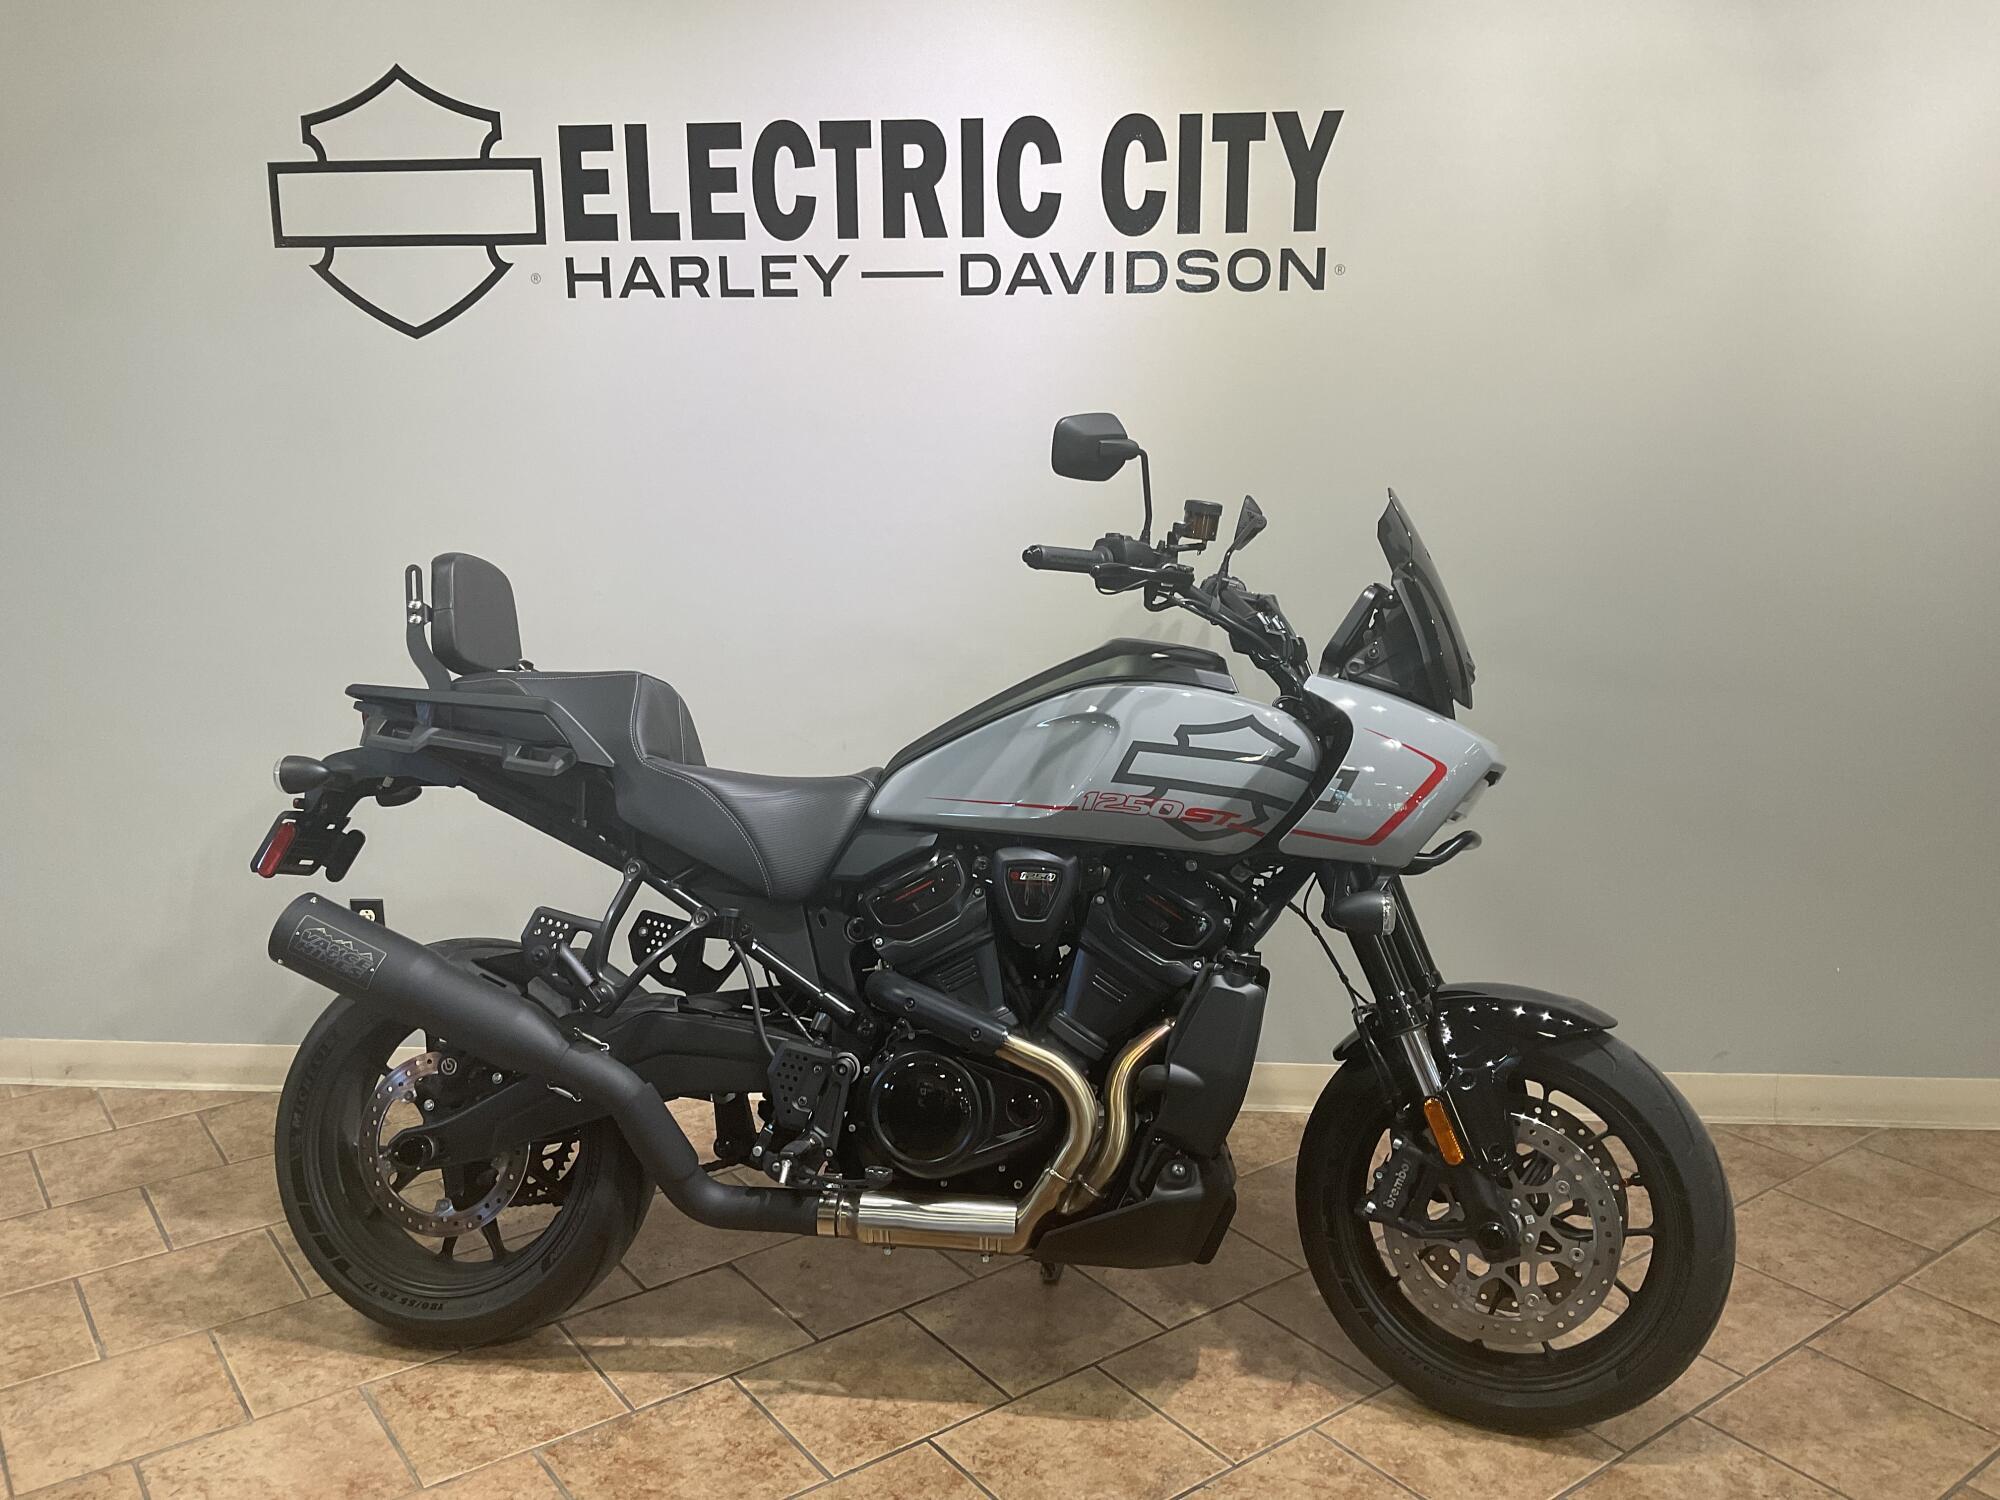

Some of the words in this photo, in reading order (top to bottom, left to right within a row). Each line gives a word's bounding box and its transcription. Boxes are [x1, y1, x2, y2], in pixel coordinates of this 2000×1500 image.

[557, 116, 1062, 242] ELECTRIC
[1101, 110, 1345, 237] CITY
[1383, 1163, 1409, 1208] brembo
